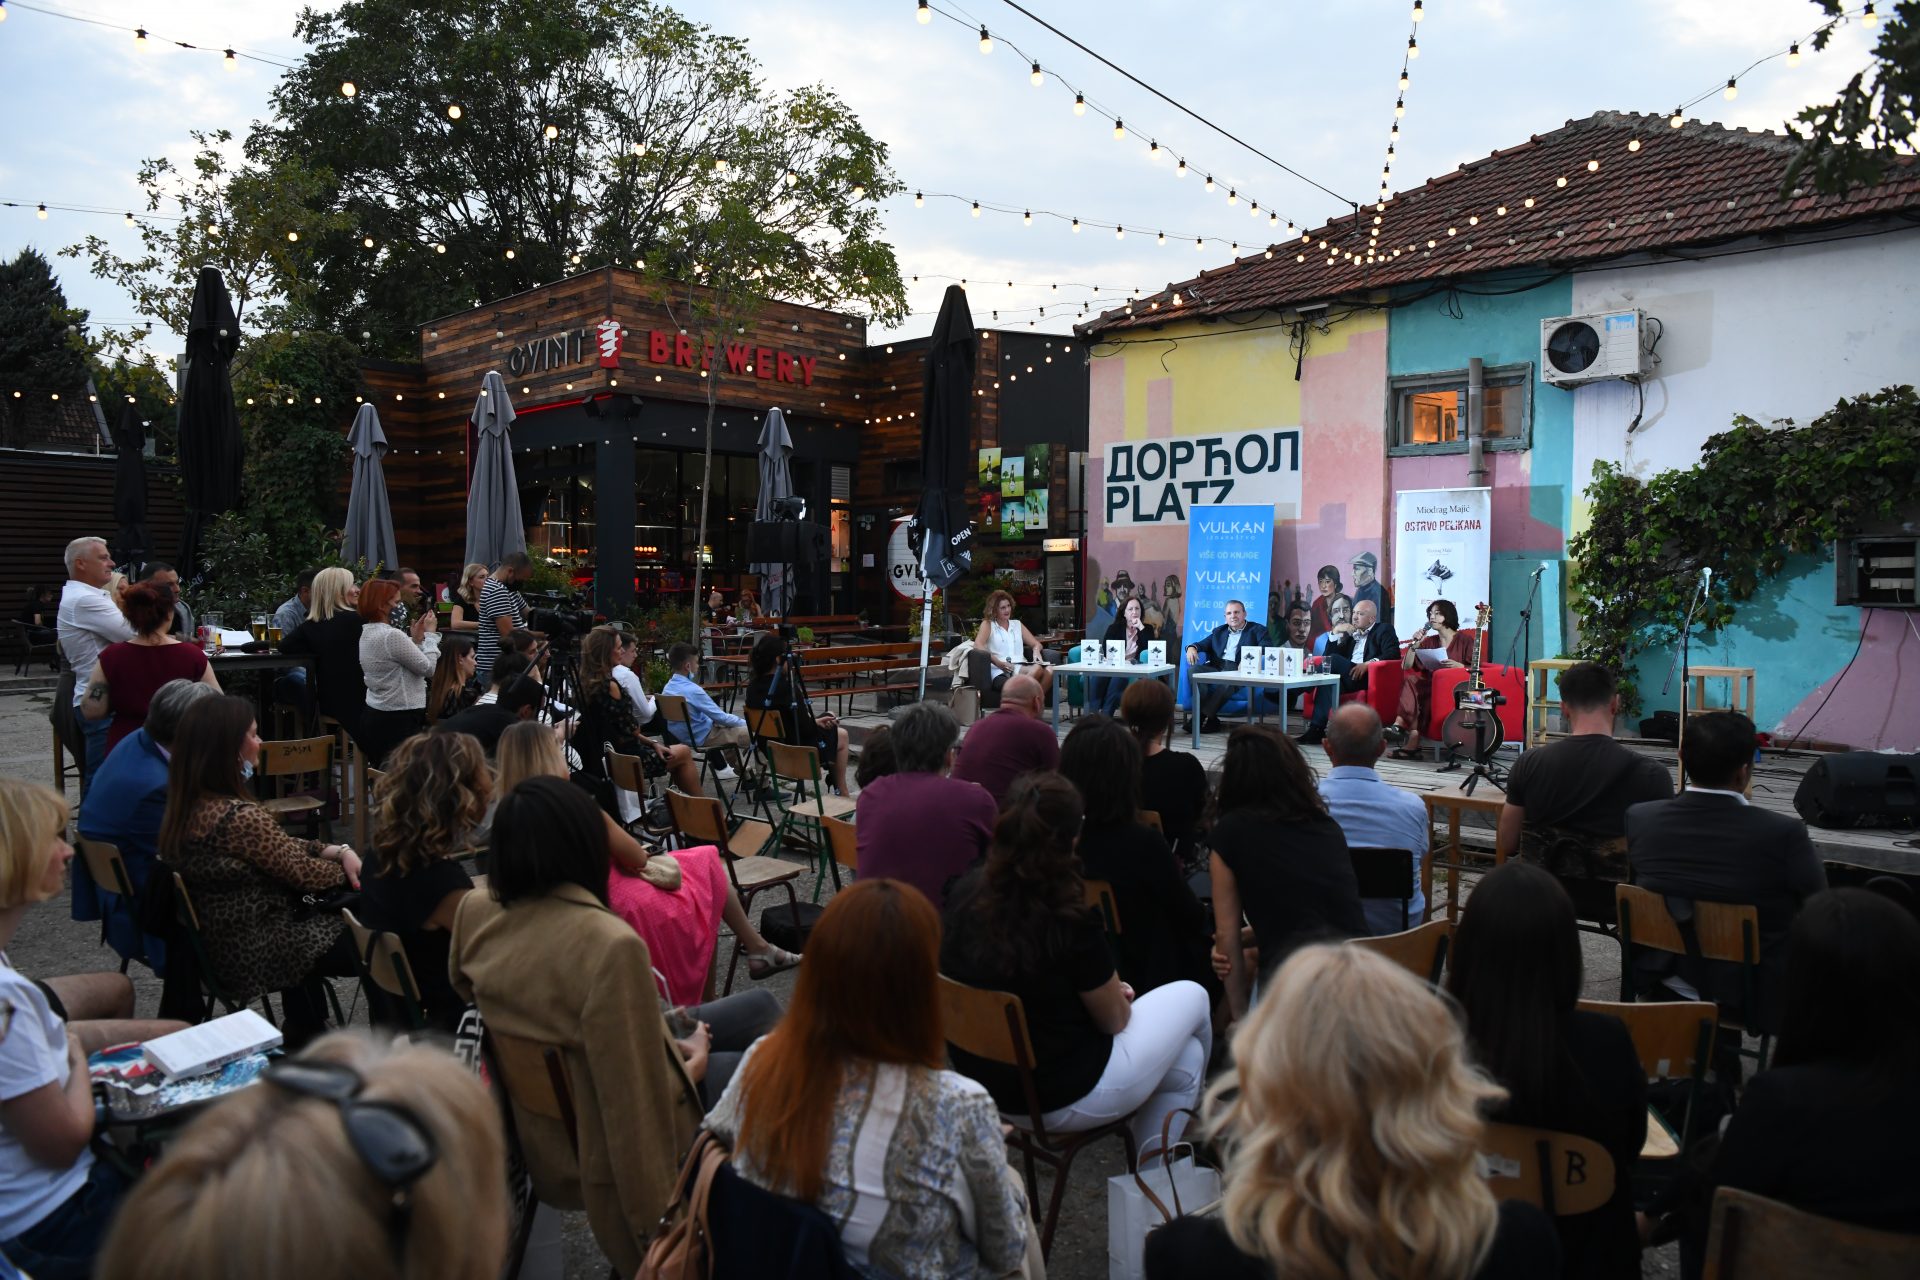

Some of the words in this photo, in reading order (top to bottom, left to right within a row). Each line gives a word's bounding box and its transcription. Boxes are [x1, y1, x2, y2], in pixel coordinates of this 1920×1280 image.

[1106, 430, 1299, 483] ДОРЋОЛ
[1416, 505, 1448, 515] Miodrag
[1198, 521, 1265, 534] VULKAN
[1404, 521, 1438, 532] OSTRVO
[950, 527, 973, 546] OPEN
[1217, 551, 1229, 560] OD
[1194, 570, 1261, 584] VULKAN
[1565, 1150, 1587, 1186] B
